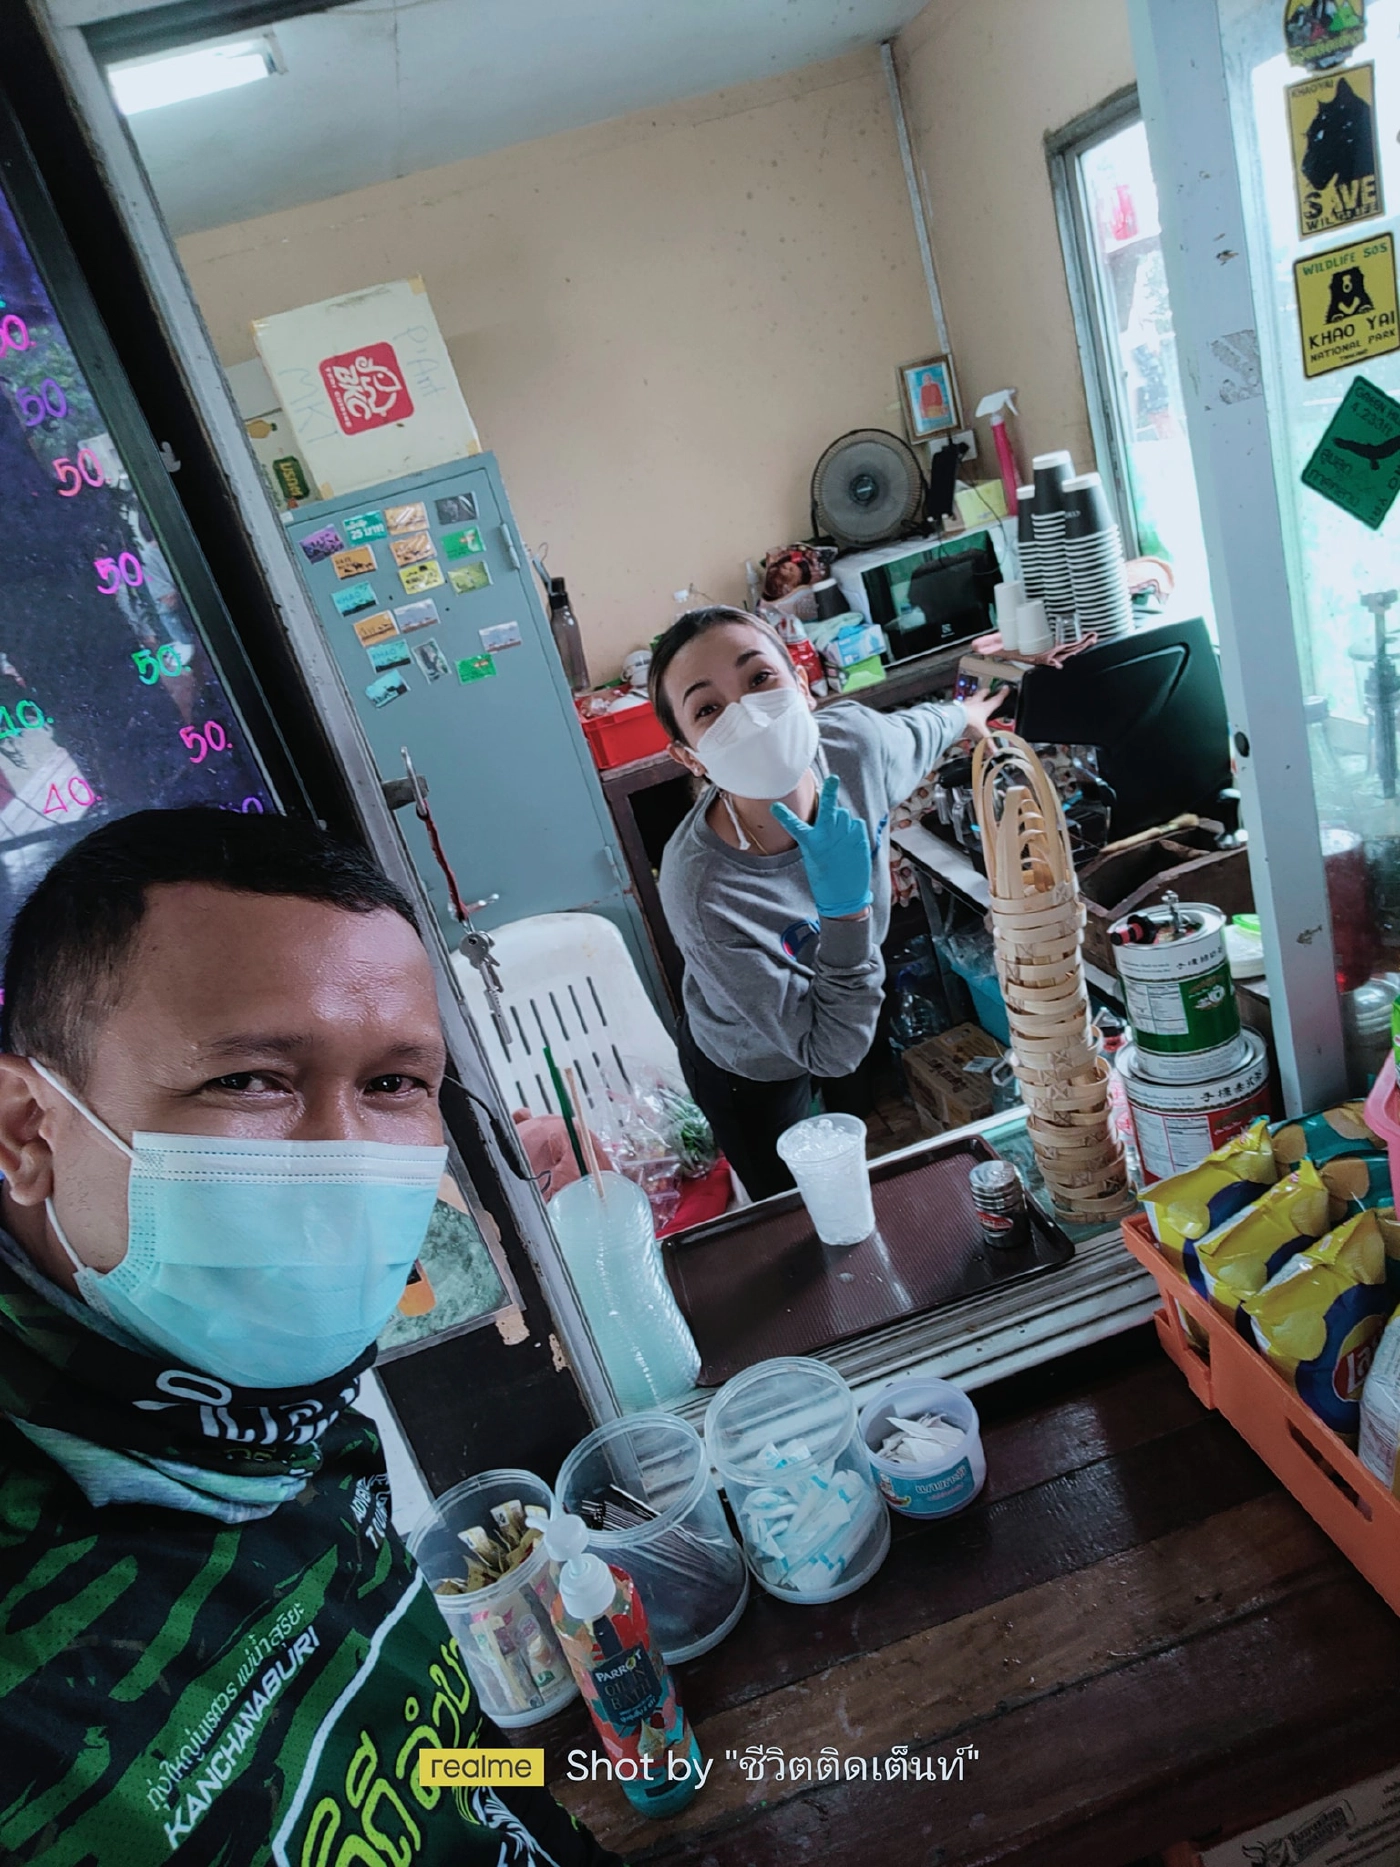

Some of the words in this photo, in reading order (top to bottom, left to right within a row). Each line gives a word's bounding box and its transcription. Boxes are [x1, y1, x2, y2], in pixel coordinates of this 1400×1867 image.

[1303, 177, 1378, 219] SAVE
[1302, 250, 1356, 277] WILDLIFE
[1363, 241, 1388, 258] SOS
[1308, 323, 1355, 350] KHAO
[1367, 309, 1396, 332] YAI
[1309, 340, 1361, 363] NATIONAL
[1368, 328, 1396, 346] PARK
[334, 363, 373, 421] BKC
[163, 1625, 322, 1851] KANCHANABURI
